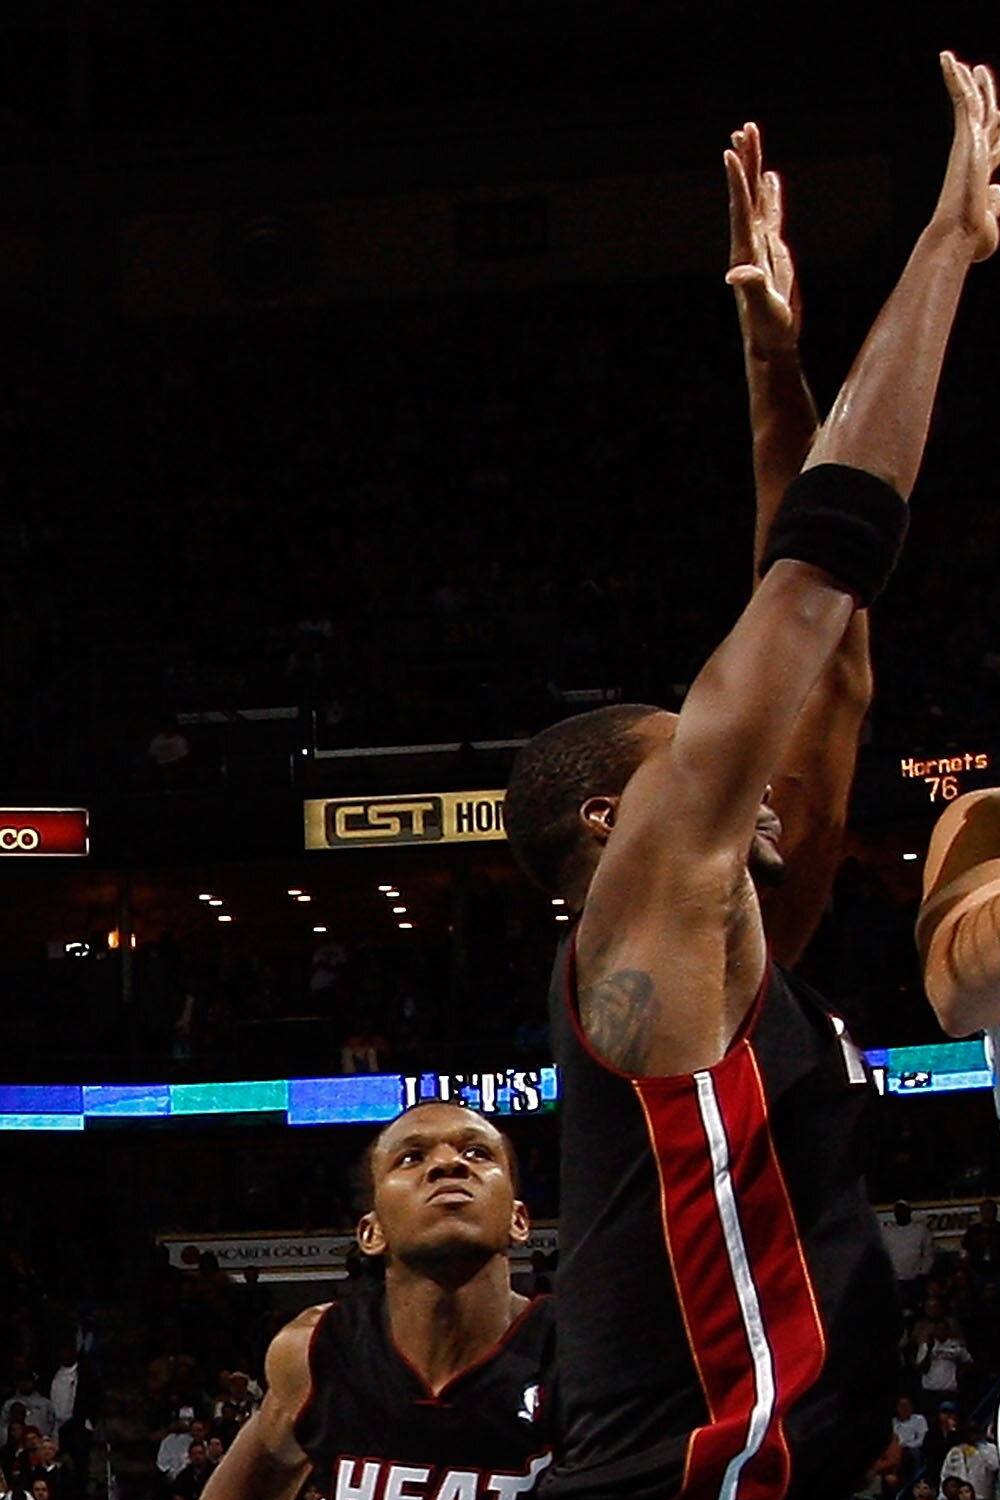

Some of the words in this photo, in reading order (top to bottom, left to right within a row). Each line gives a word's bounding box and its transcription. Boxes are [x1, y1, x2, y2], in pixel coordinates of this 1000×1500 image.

[901, 753, 988, 778] Hornets
[924, 776, 958, 802] 76
[335, 802, 435, 838] CST
